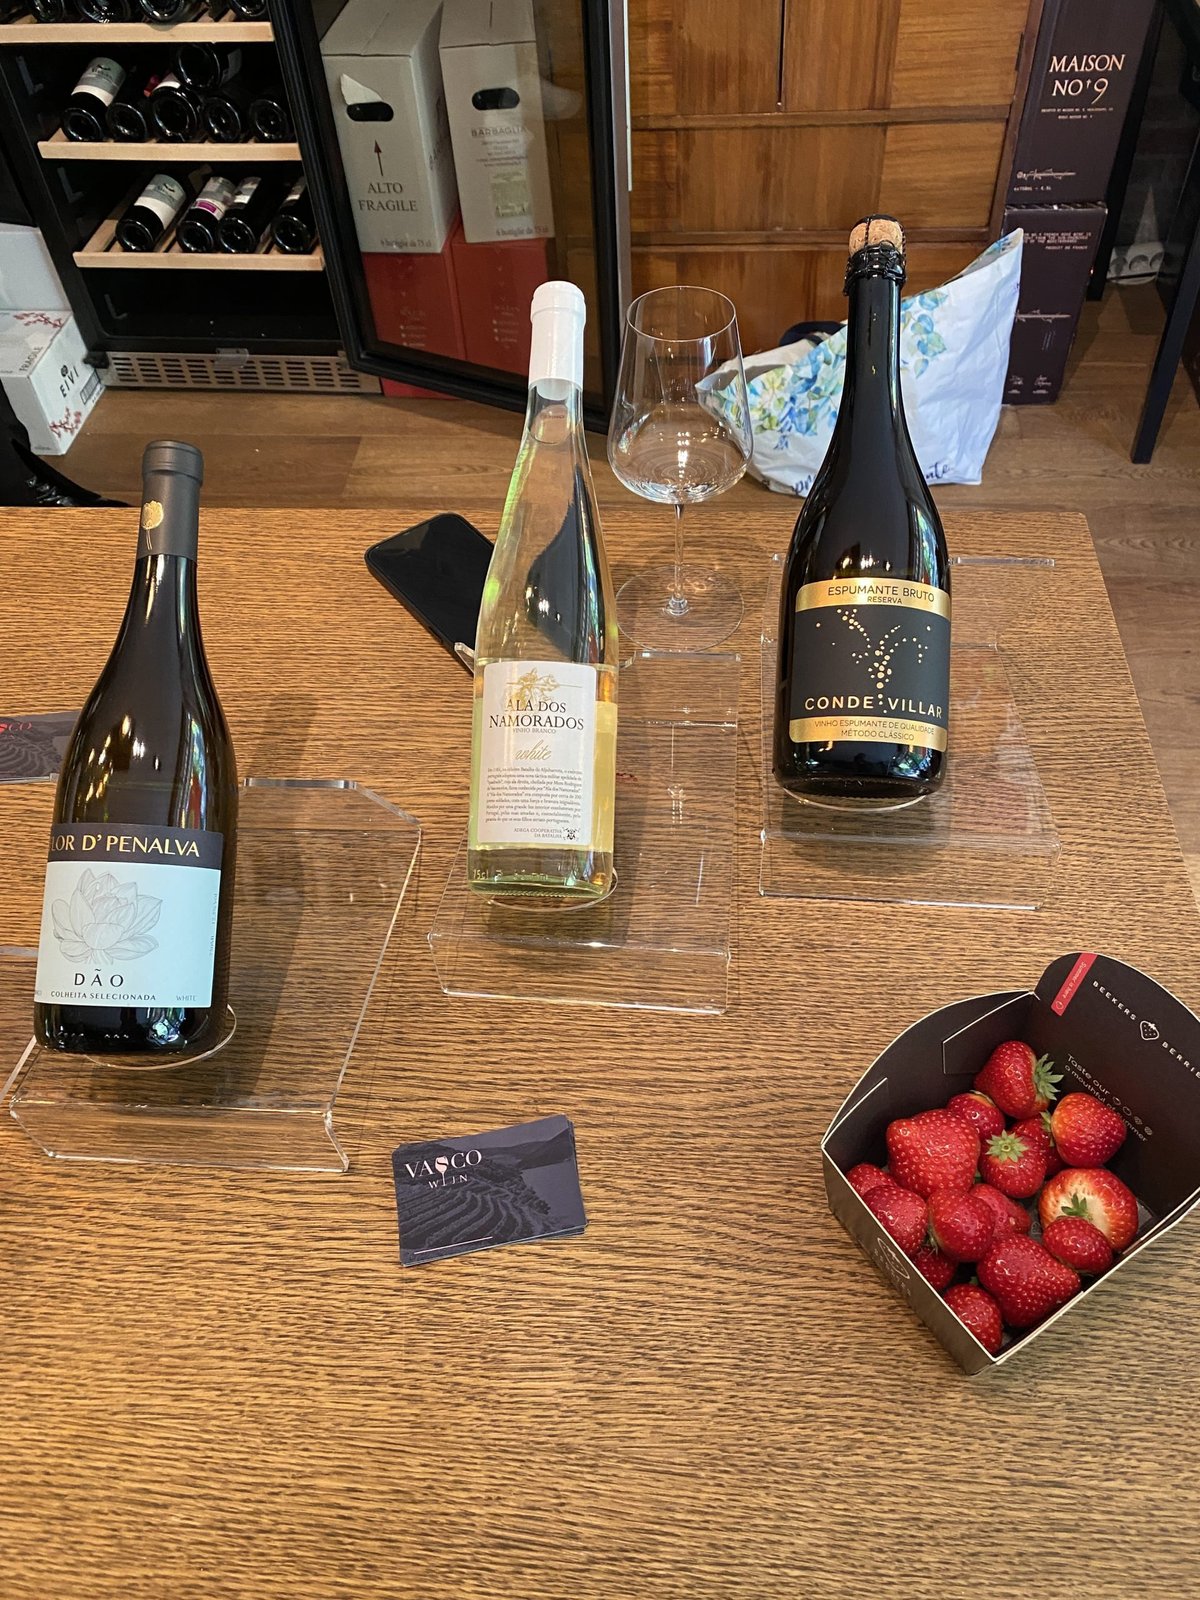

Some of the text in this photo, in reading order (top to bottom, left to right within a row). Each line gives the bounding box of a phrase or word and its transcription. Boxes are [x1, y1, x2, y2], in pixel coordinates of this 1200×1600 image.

[1049, 54, 1126, 73] MAISON
[368, 182, 403, 194] ALTO
[358, 199, 418, 212] FRAGILE
[60, 366, 79, 398] EIVI
[828, 585, 935, 602] ESPUMANTE BRUTO
[867, 595, 903, 604] RESERVA
[505, 699, 566, 713] ALA DOS
[804, 696, 942, 719] CONDE VILLAR
[489, 714, 584, 730] NAMORADOS
[814, 719, 935, 735] VINHO ESPUMANTE DE QUALIDADE
[841, 729, 914, 741] MÉTODO CLÁSSICO
[515, 739, 552, 760] white
[74, 968, 124, 987] DÃO
[50, 991, 87, 999] COLHEITA
[90, 992, 156, 1001] SELECIONADA
[1093, 980, 1136, 1021] BEEKERS
[1067, 1053, 1111, 1095] Taste our
[1064, 1064, 1071, 1072] a
[1071, 1070, 1106, 1102] mouthful
